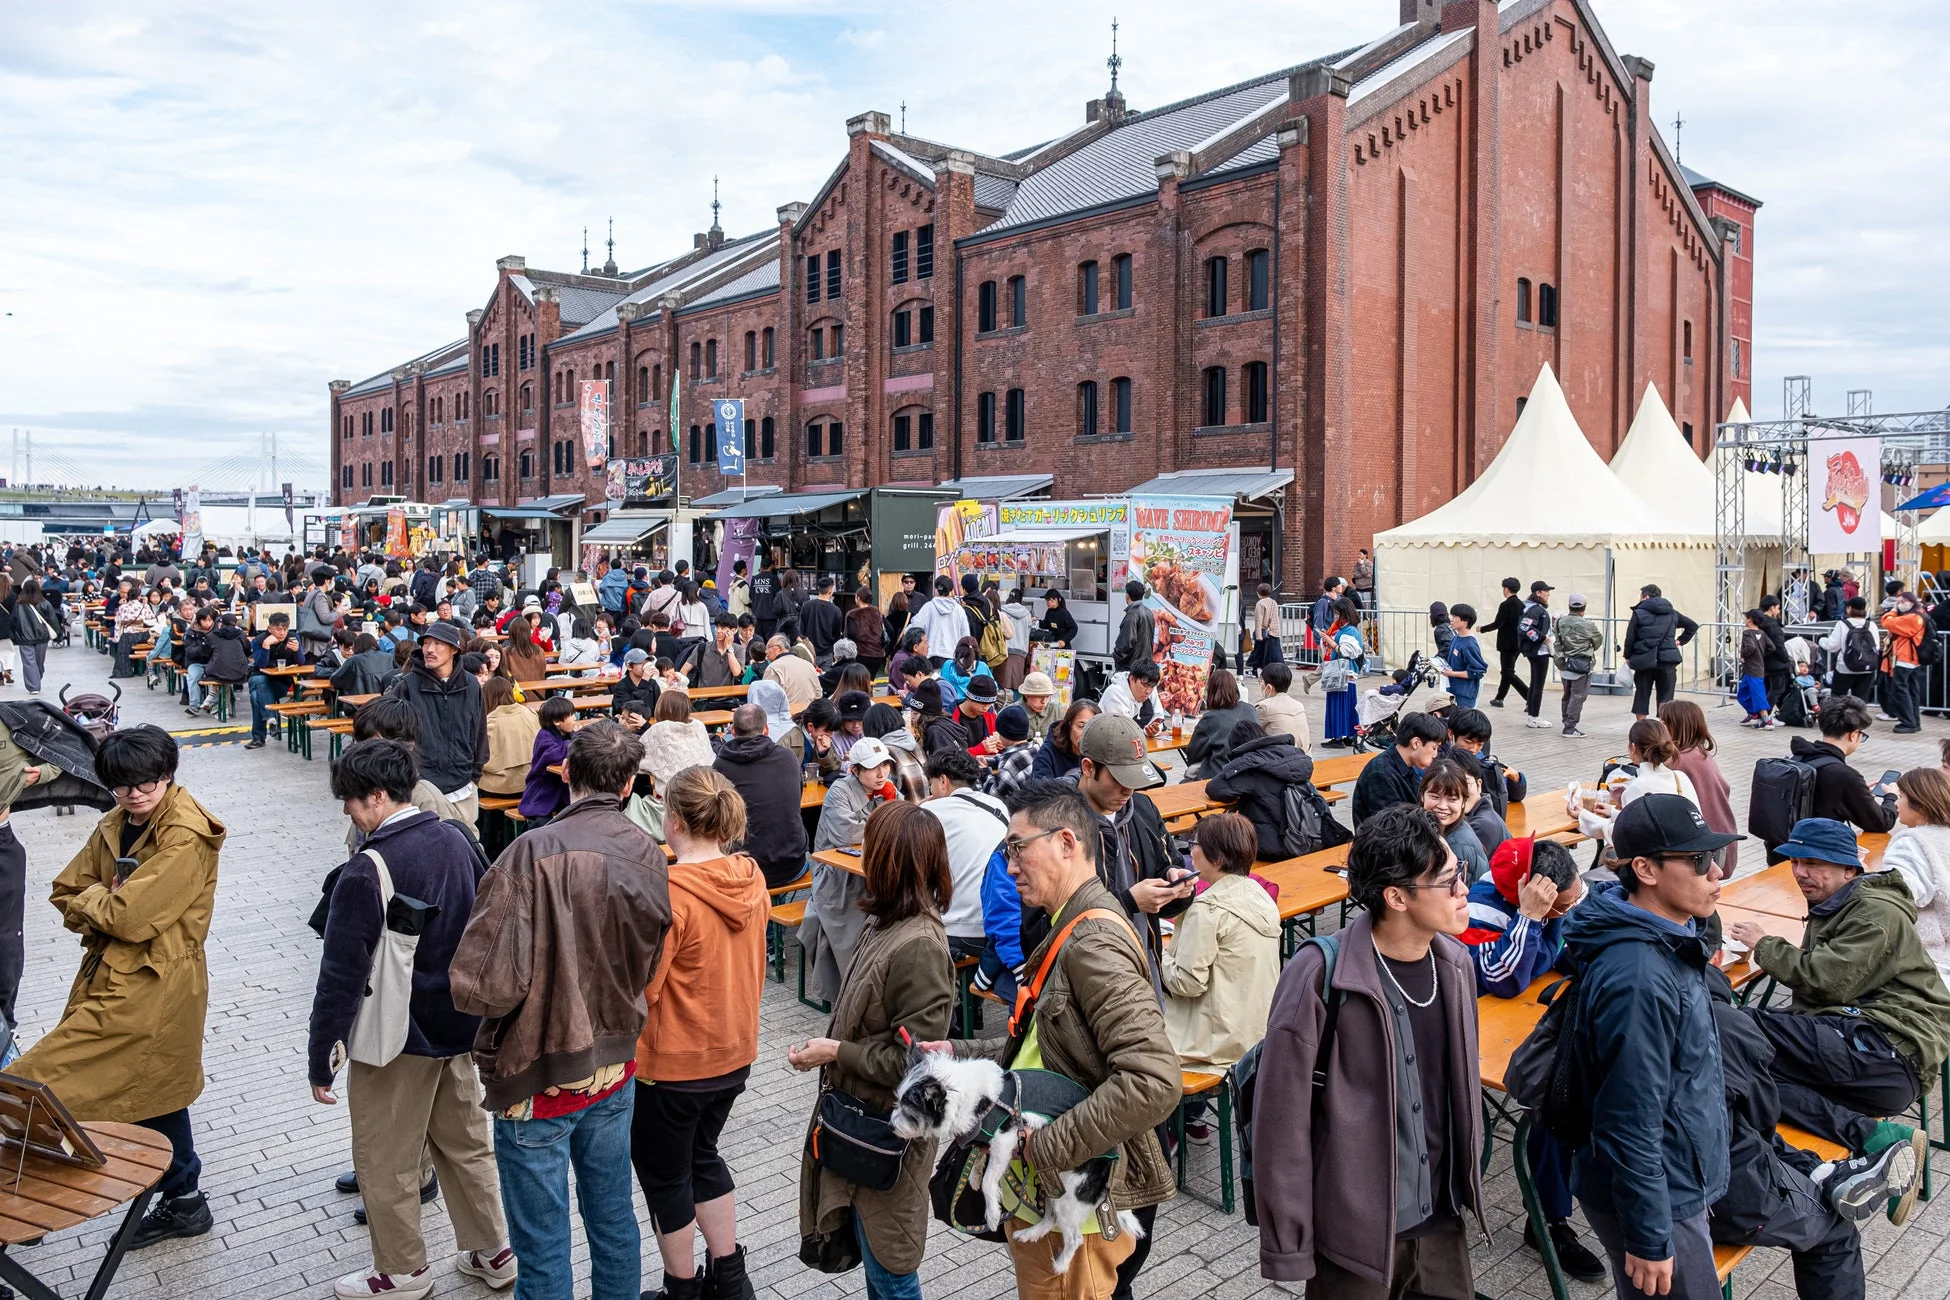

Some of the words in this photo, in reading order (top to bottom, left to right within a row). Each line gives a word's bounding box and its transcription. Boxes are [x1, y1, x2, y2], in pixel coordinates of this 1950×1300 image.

[1001, 504, 1127, 524] 焼きたてガーリックシュリンプ
[1135, 507, 1169, 529] WAVE
[1173, 508, 1230, 532] SHRIMP
[964, 515, 993, 541] 40CM
[1188, 547, 1224, 559] スキャンピ
[1132, 738, 1145, 760] B
[366, 1262, 396, 1294] N
